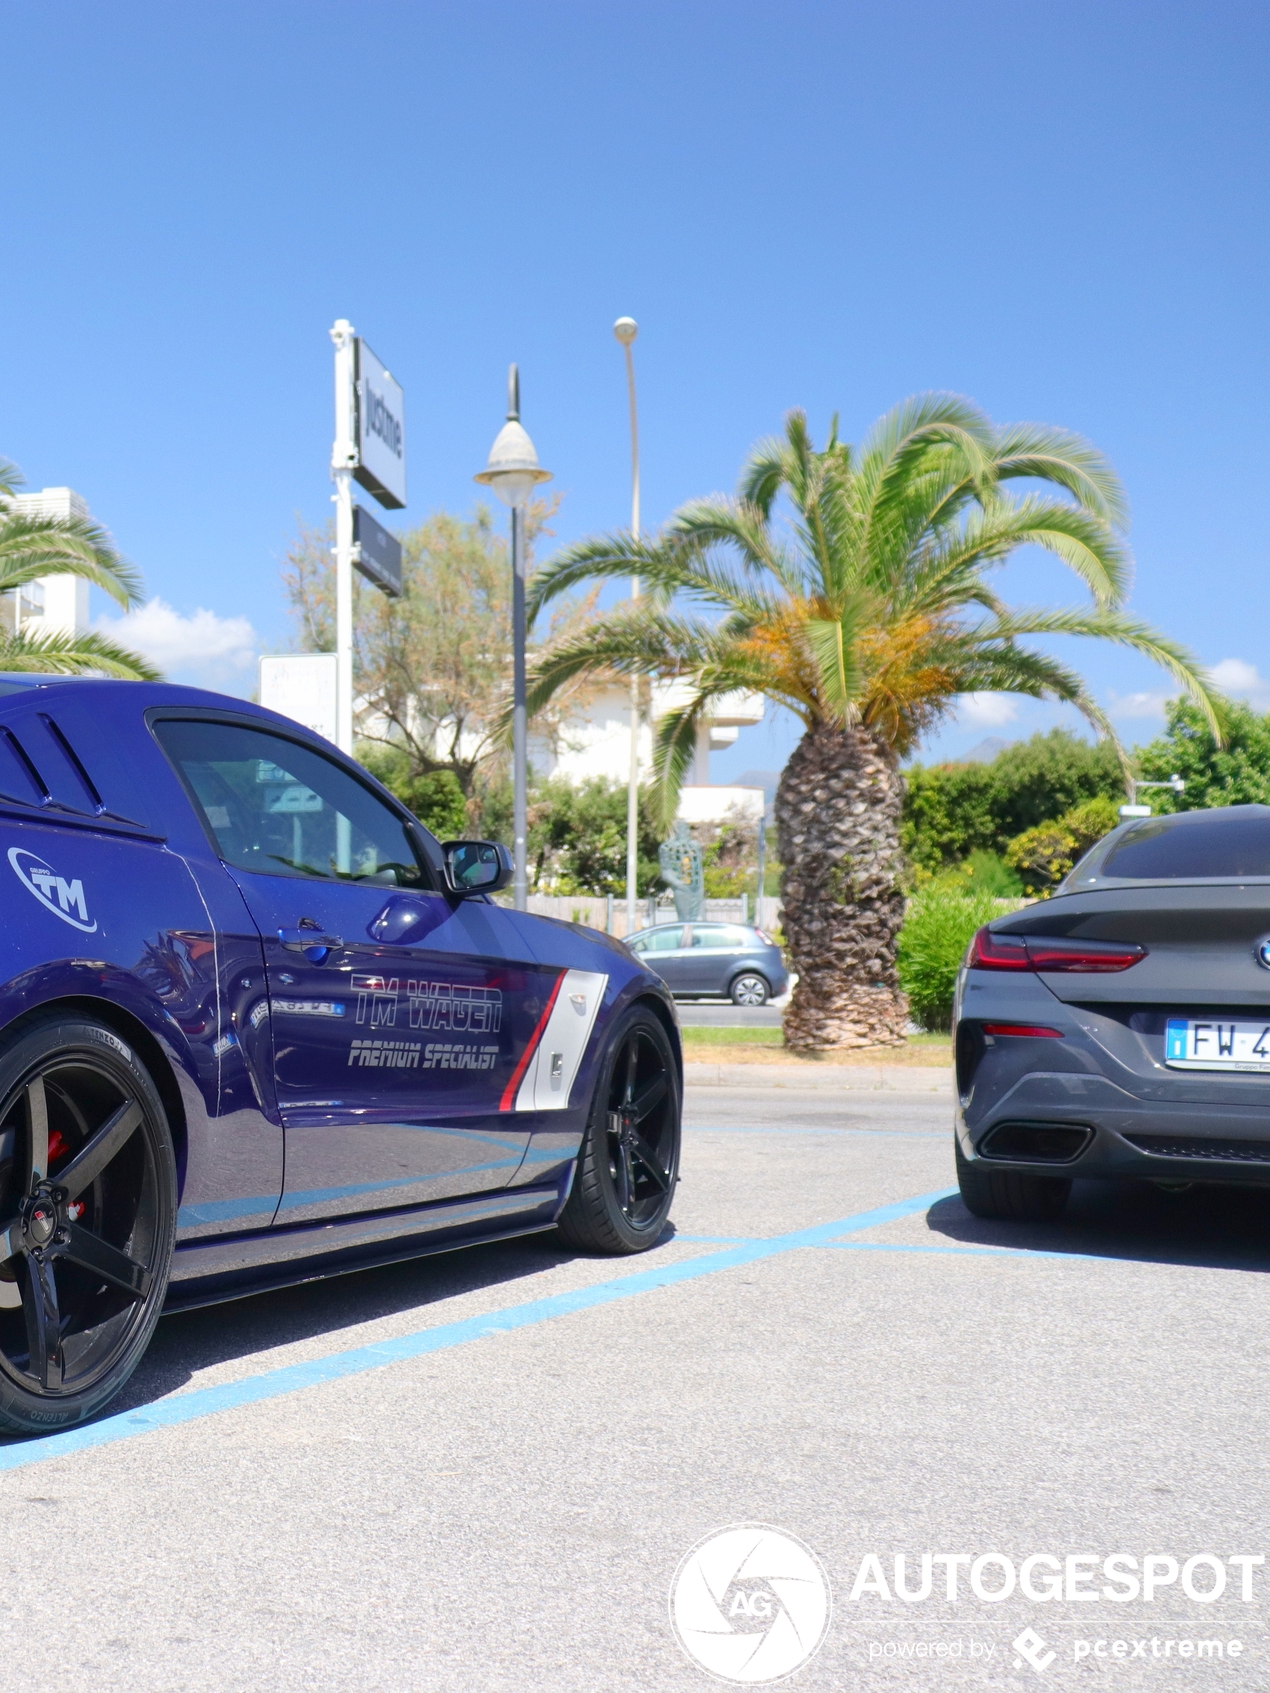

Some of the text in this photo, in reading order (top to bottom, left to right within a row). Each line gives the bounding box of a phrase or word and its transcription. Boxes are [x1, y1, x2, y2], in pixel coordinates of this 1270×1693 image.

[31, 873, 89, 921] TM
[350, 973, 400, 1027] TM
[347, 1039, 500, 1070] PREMIUM SPECIALIST
[1193, 1023, 1237, 1057] FW
